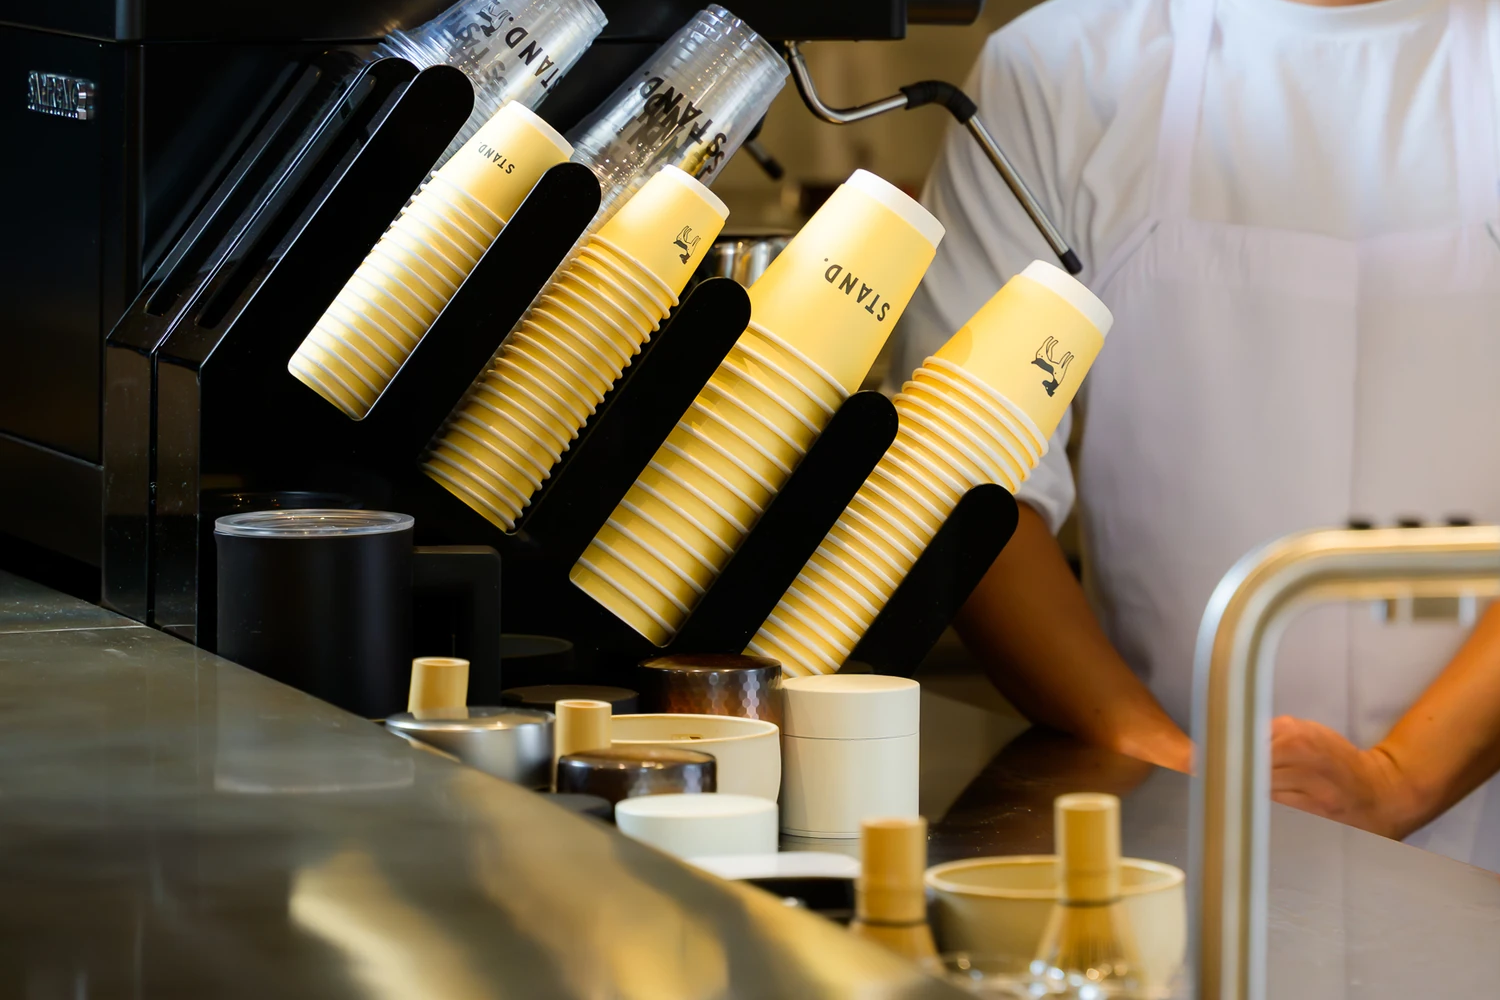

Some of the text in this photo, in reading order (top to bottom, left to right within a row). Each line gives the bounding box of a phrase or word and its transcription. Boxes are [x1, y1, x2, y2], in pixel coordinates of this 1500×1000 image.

[639, 71, 727, 158] STAND.
[478, 141, 515, 174] STAND.
[824, 257, 891, 322] STAND.
